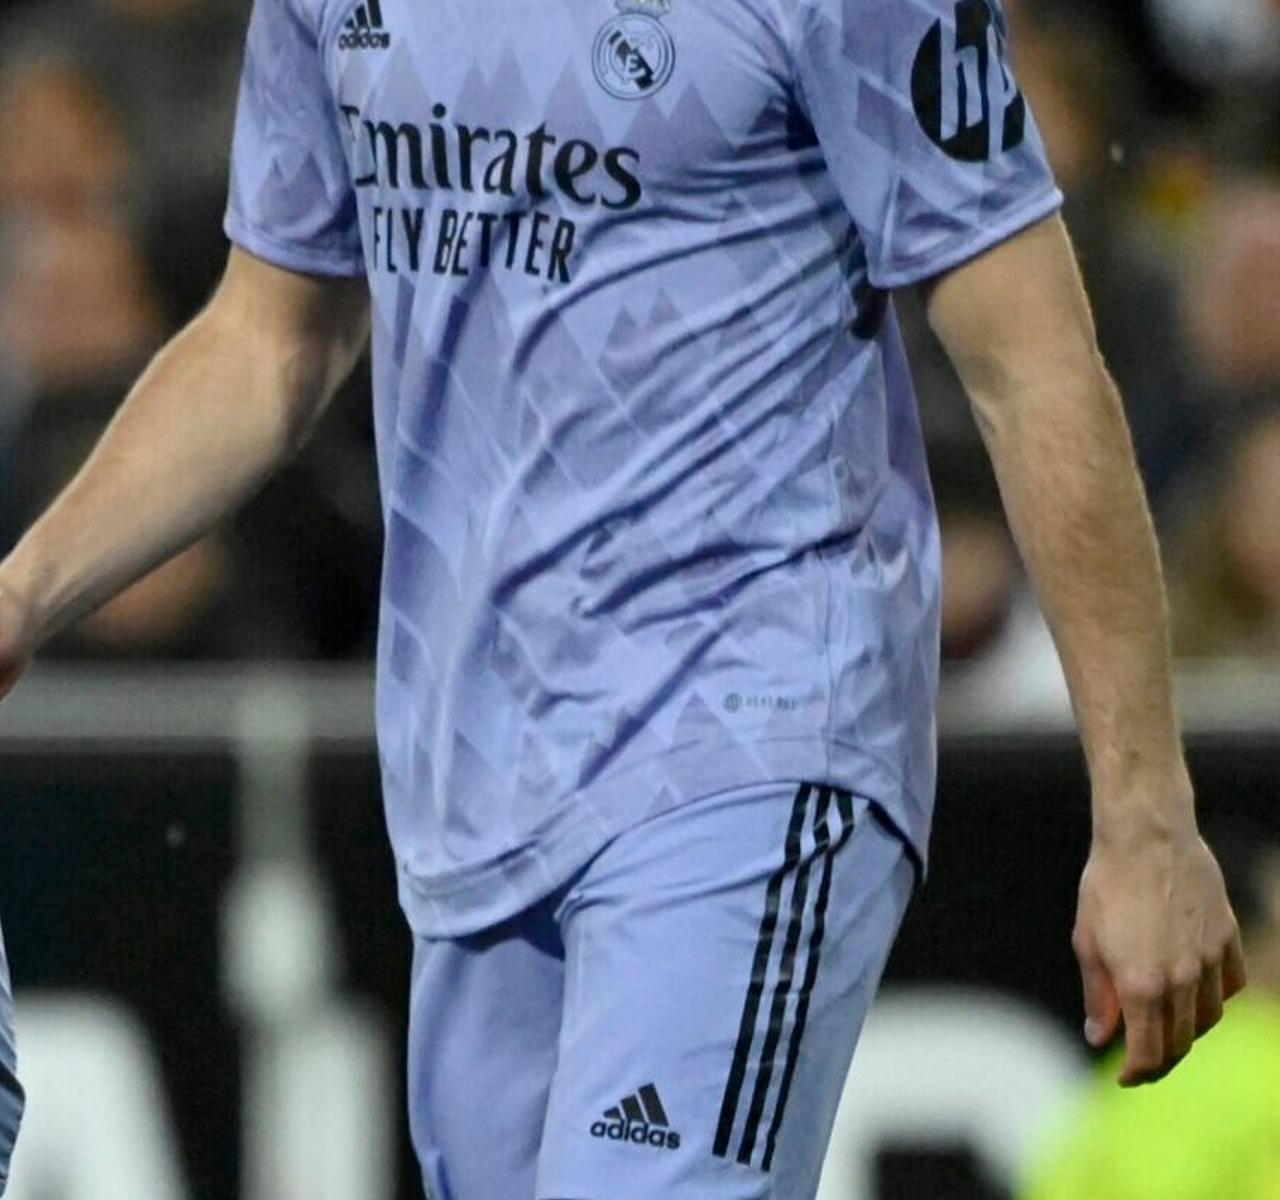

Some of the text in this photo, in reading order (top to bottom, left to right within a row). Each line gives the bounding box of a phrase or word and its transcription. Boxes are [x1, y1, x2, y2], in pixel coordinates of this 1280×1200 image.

[373, 206, 576, 284] FLY BETTER
[590, 1117, 681, 1150] adidas
